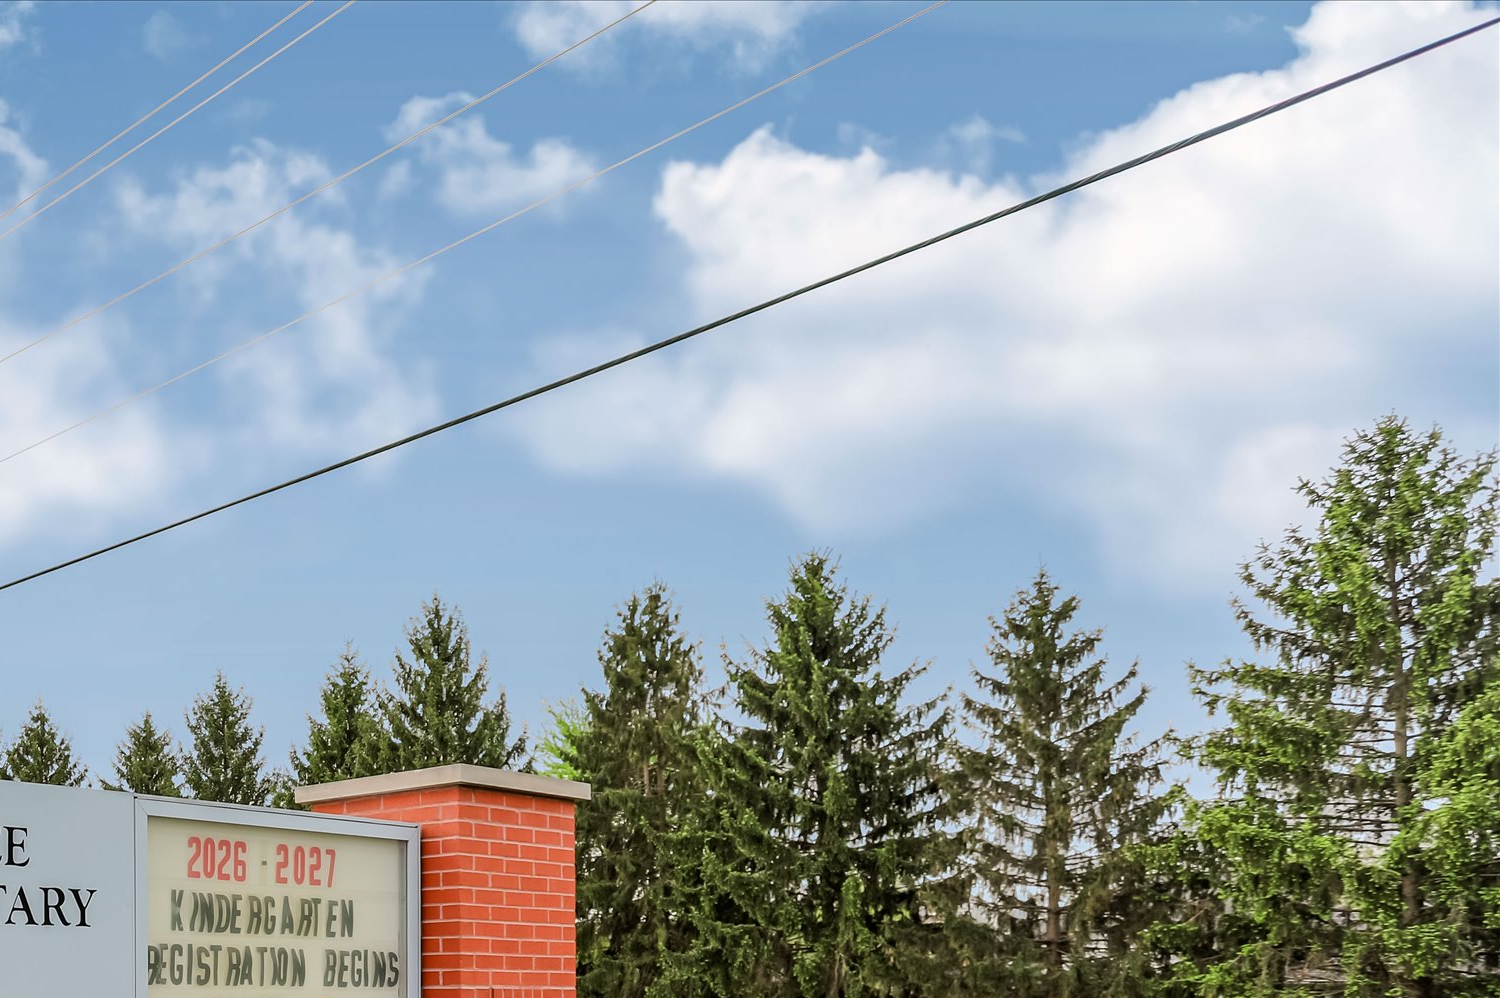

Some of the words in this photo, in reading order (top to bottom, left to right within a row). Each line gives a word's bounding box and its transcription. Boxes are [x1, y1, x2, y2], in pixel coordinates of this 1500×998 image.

[187, 836, 247, 882] 2026
[275, 843, 336, 888] 2027
[171, 889, 354, 938] KINDERGARTEN
[148, 943, 306, 987] REGISTRATION
[323, 949, 399, 988] BEGINS
